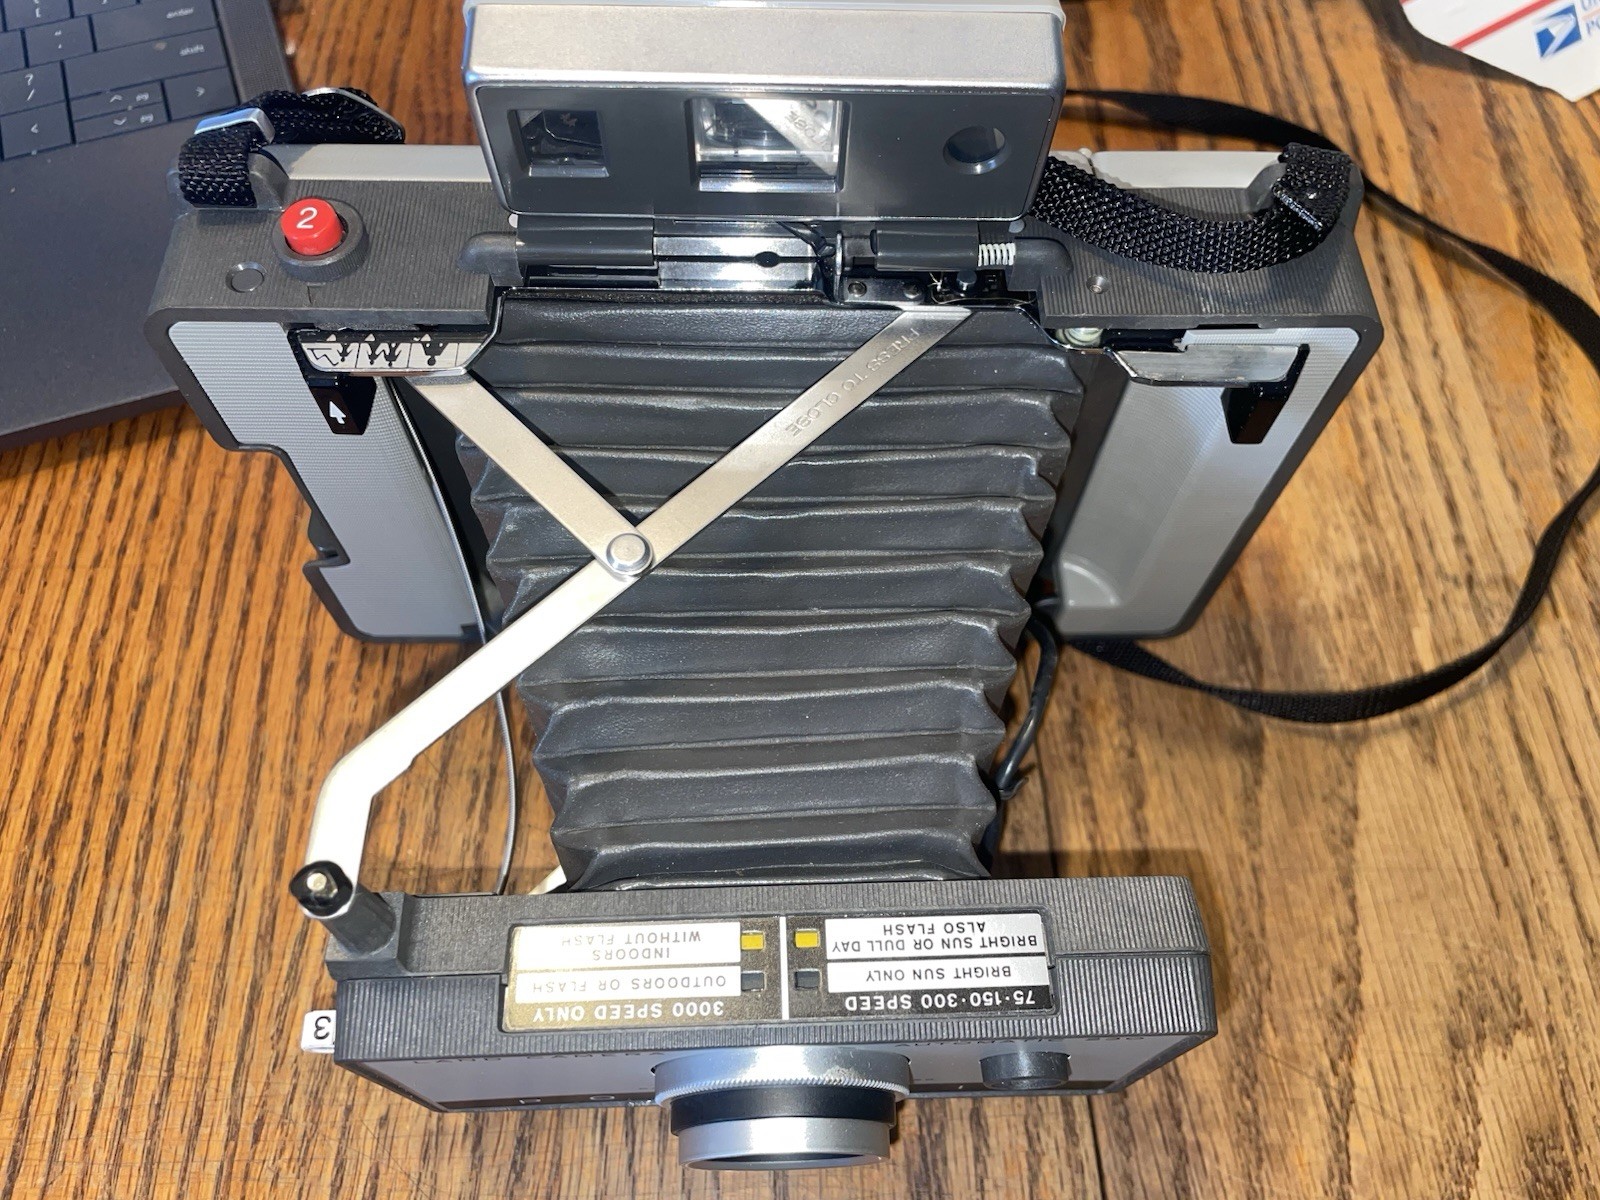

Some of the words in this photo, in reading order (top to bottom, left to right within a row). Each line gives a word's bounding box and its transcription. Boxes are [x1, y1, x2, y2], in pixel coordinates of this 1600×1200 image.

[296, 206, 318, 229] 2
[866, 328, 920, 372] PRESS
[841, 372, 868, 392] TO
[785, 391, 841, 437] CLOSE
[883, 923, 935, 936] FLASH
[943, 921, 986, 934] ALSO
[561, 933, 615, 947] FLASH
[624, 930, 702, 945] WITHOUT
[912, 938, 934, 951] OR
[941, 937, 973, 950] SUN
[980, 935, 1038, 948] BRIGHT
[832, 940, 861, 953] DAY
[870, 939, 905, 951] DULL
[592, 947, 671, 961] INDOORS
[866, 969, 905, 982] ONLY
[912, 967, 946, 980] SUN
[953, 965, 1012, 980] BRIGHT
[532, 980, 587, 994] FLASH
[598, 979, 621, 992] OR
[631, 975, 726, 990] OUTDOORS
[672, 1001, 724, 1018] 3000
[845, 994, 912, 1012] SPEED
[532, 1005, 585, 1023] ONLY
[594, 1003, 663, 1020] SPEED
[313, 1015, 331, 1040] 3
